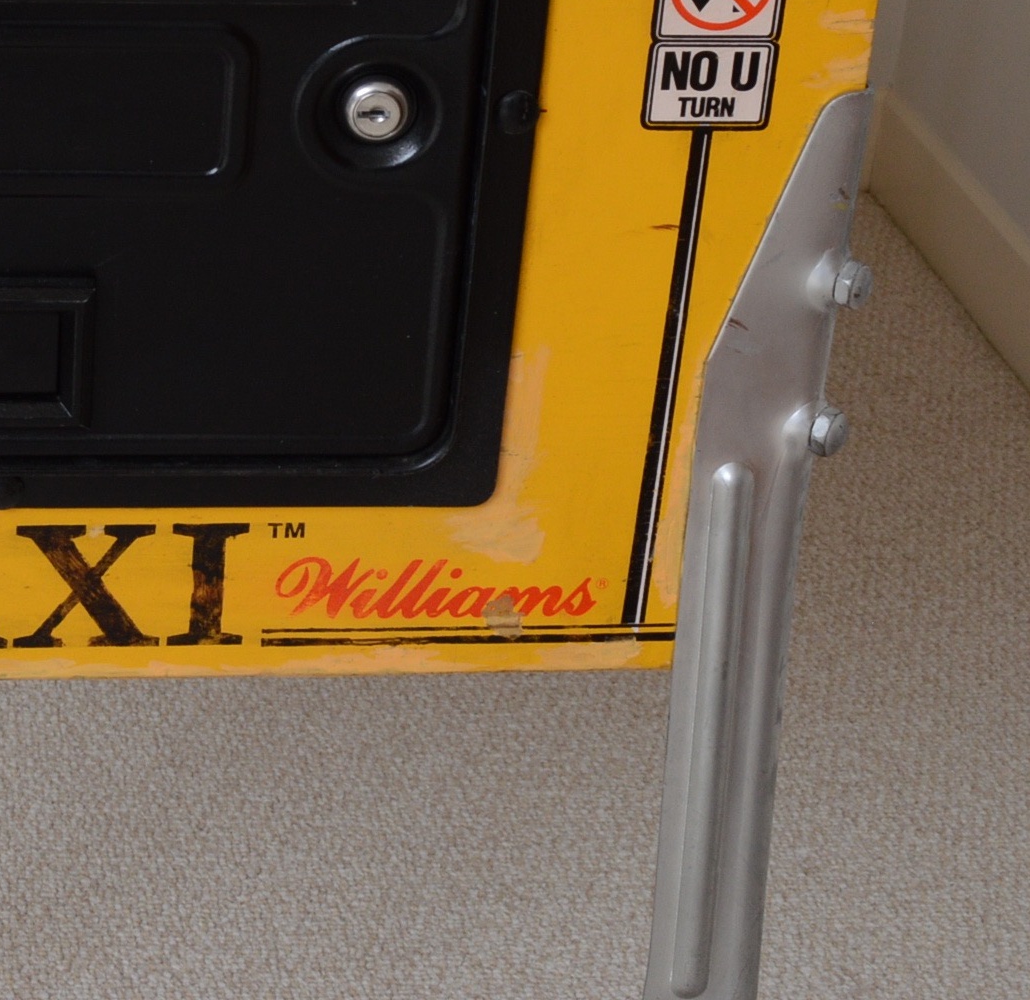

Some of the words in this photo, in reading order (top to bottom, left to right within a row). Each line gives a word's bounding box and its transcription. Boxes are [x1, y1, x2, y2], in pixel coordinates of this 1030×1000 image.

[661, 50, 719, 92] NO
[731, 50, 761, 92] U
[677, 97, 736, 118] TURN
